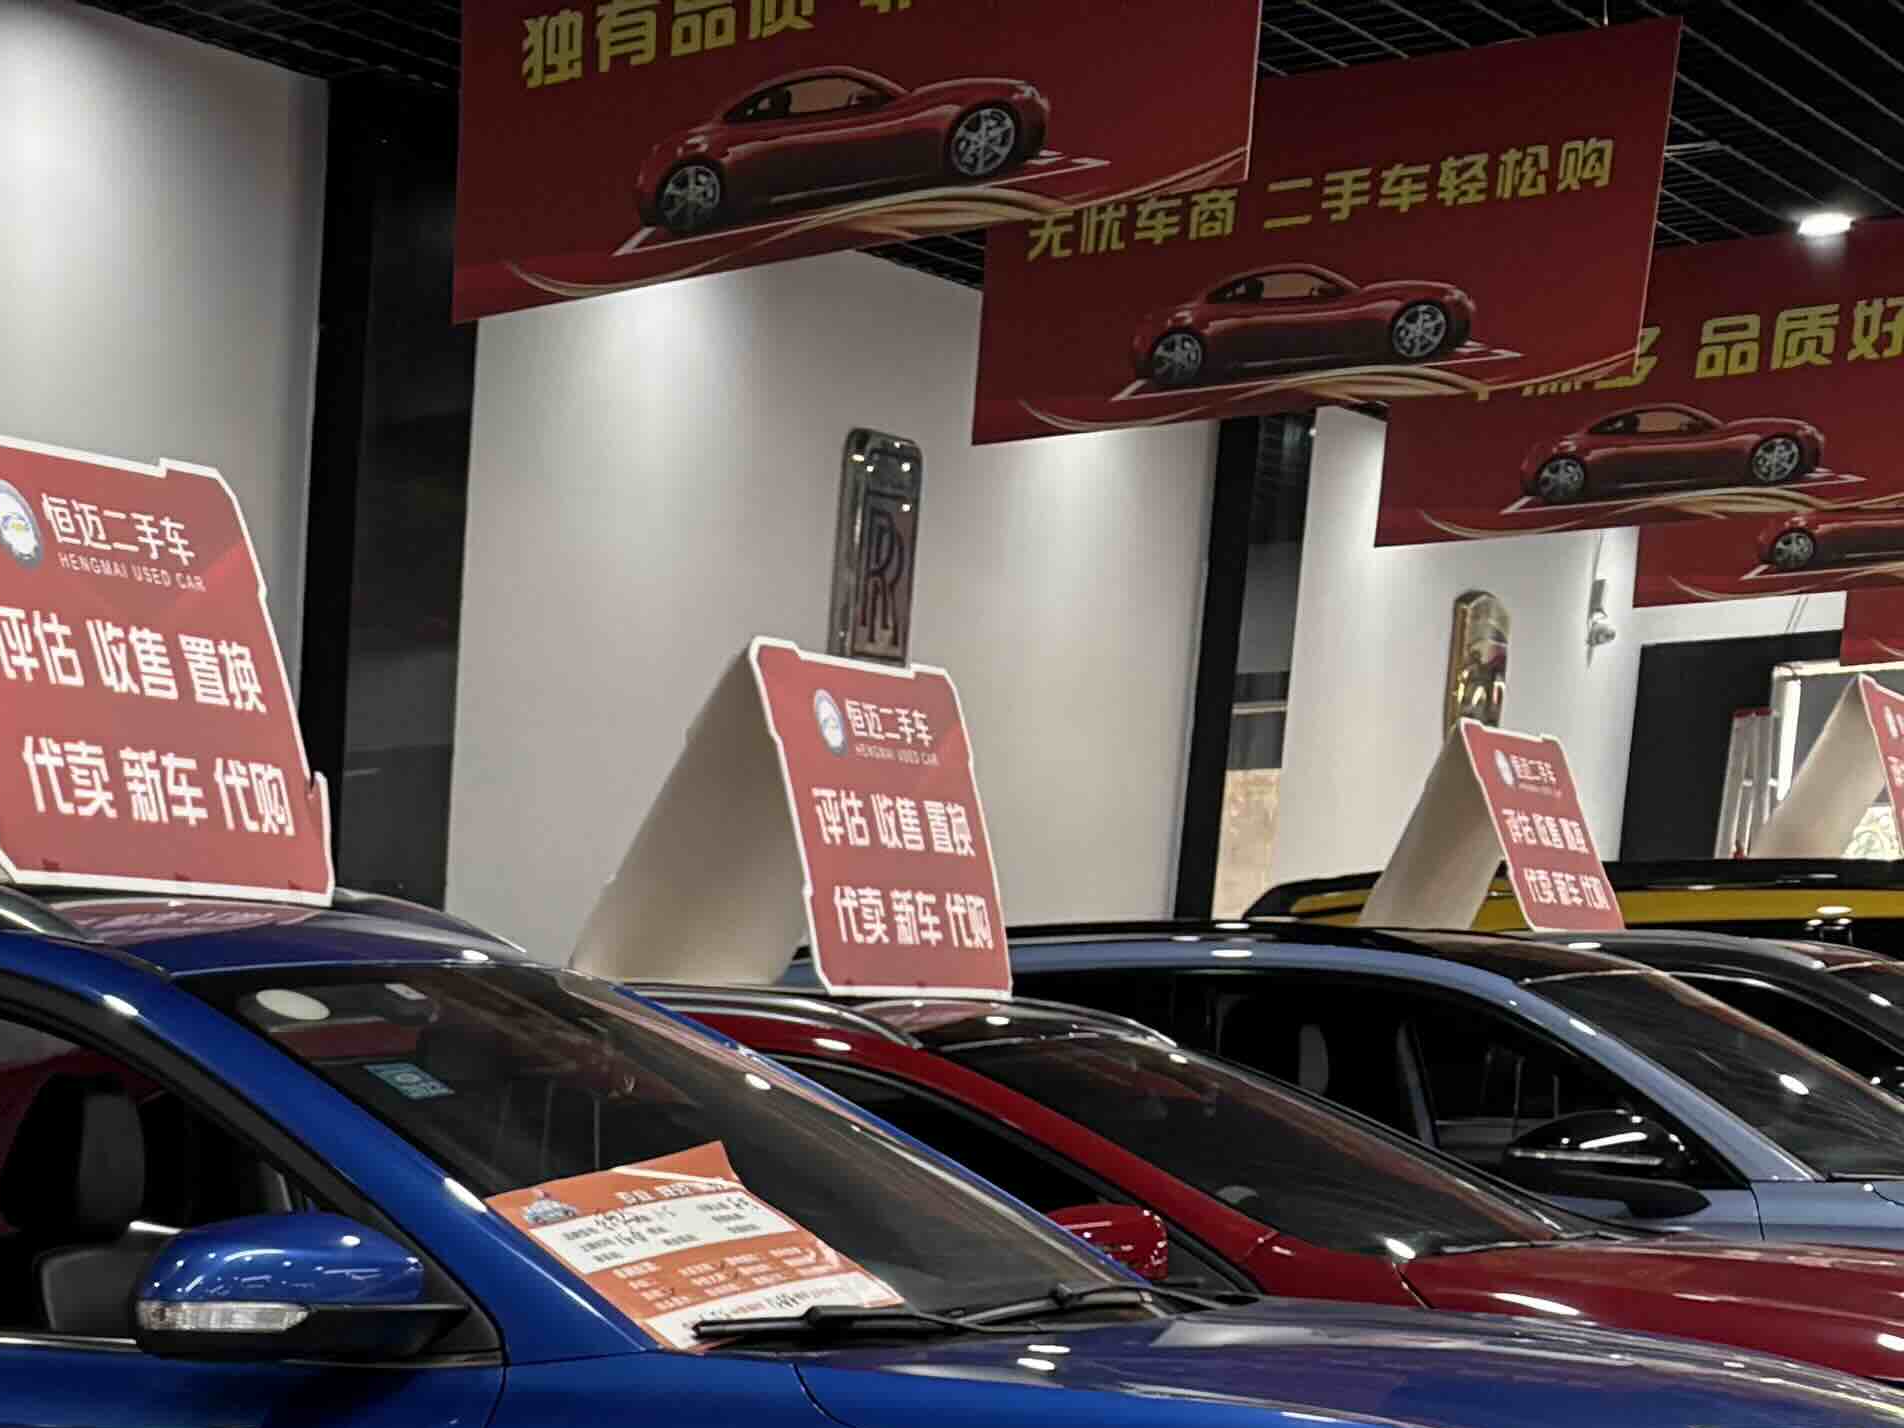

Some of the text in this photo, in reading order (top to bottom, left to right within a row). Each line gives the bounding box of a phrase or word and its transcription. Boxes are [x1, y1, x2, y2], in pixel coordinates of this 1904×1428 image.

[1027, 137, 1616, 261] 无忧车商 二手车轻松购
[1695, 295, 1904, 379] 品质好
[41, 492, 195, 567] 恒迈二手车
[57, 552, 207, 593] HENGMAI USED CAR
[86, 619, 179, 700] 收售
[178, 633, 267, 714] 置换
[22, 735, 296, 837] 代卖 新车 代购
[812, 787, 976, 857] 评估 收售 置换
[833, 885, 994, 950] 代卖 新车 代购
